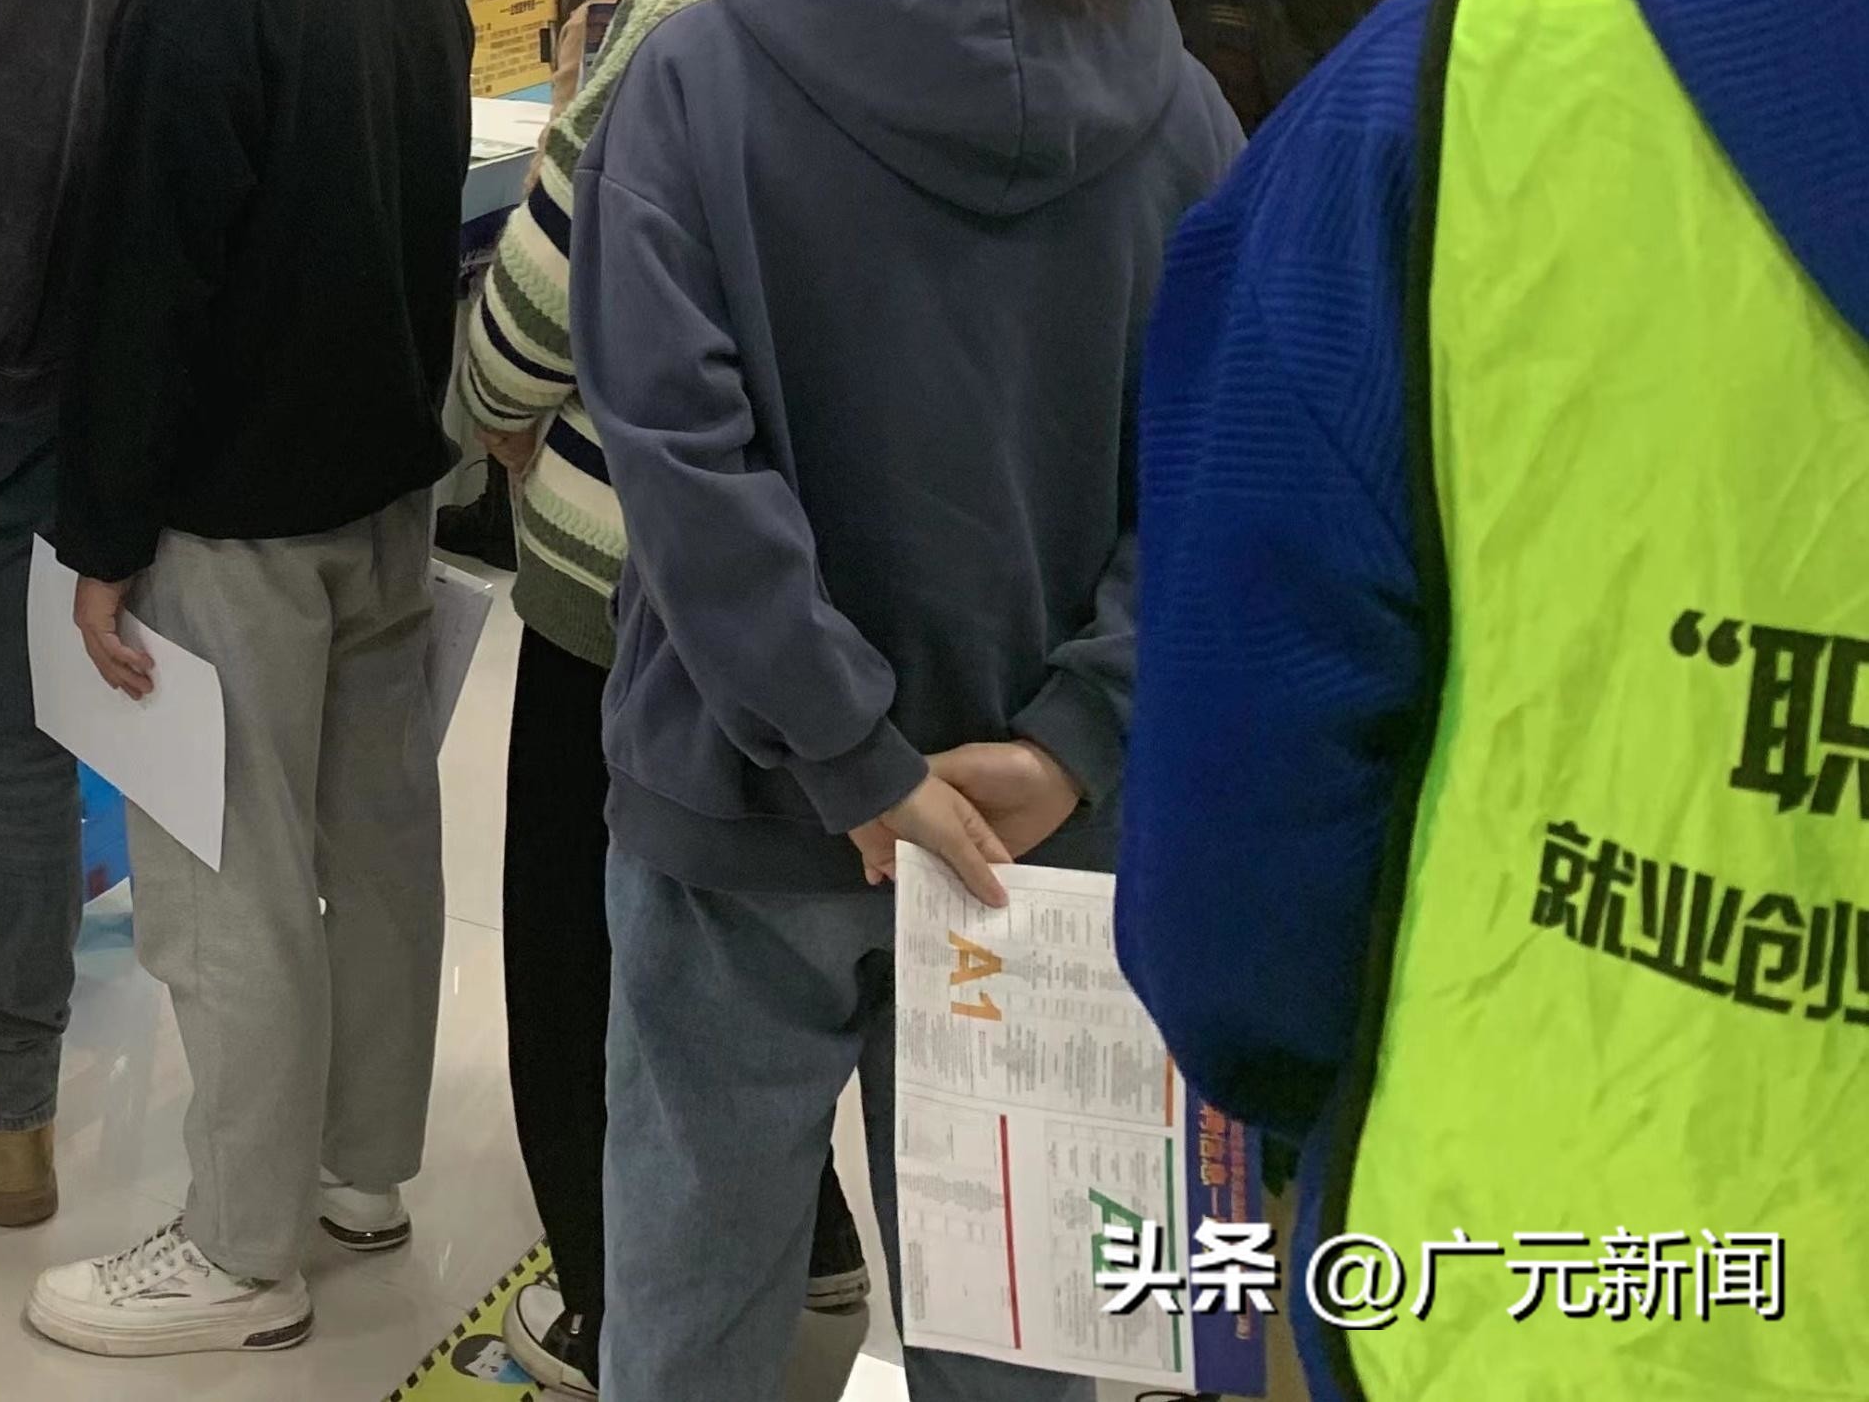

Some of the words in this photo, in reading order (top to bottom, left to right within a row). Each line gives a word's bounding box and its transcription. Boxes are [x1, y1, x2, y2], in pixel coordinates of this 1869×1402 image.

[948, 930, 1002, 1021] A1
[1531, 820, 1869, 1026] 就业创
